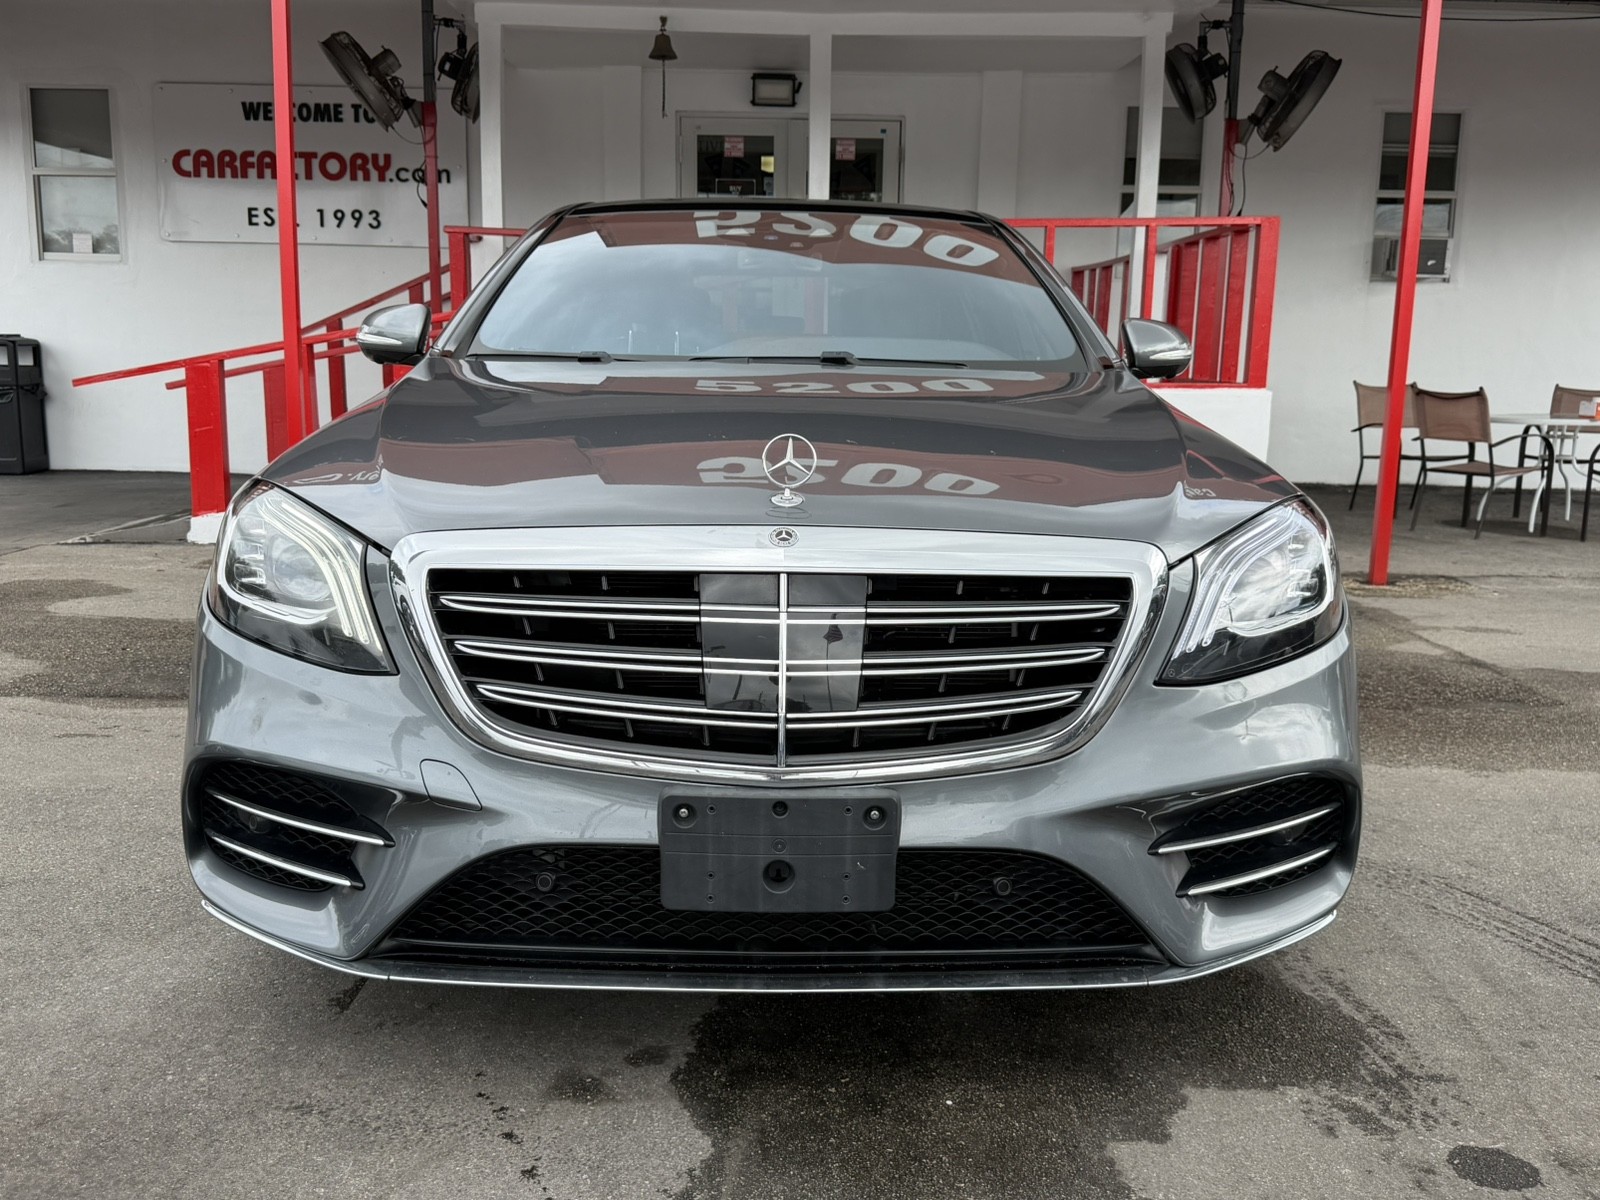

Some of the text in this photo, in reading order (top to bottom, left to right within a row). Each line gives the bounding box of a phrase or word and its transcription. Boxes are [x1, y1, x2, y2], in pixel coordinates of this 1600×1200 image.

[241, 101, 343, 123] WEOME
[172, 149, 451, 184] CARFATORY.com
[247, 207, 382, 229] ES. 1993
